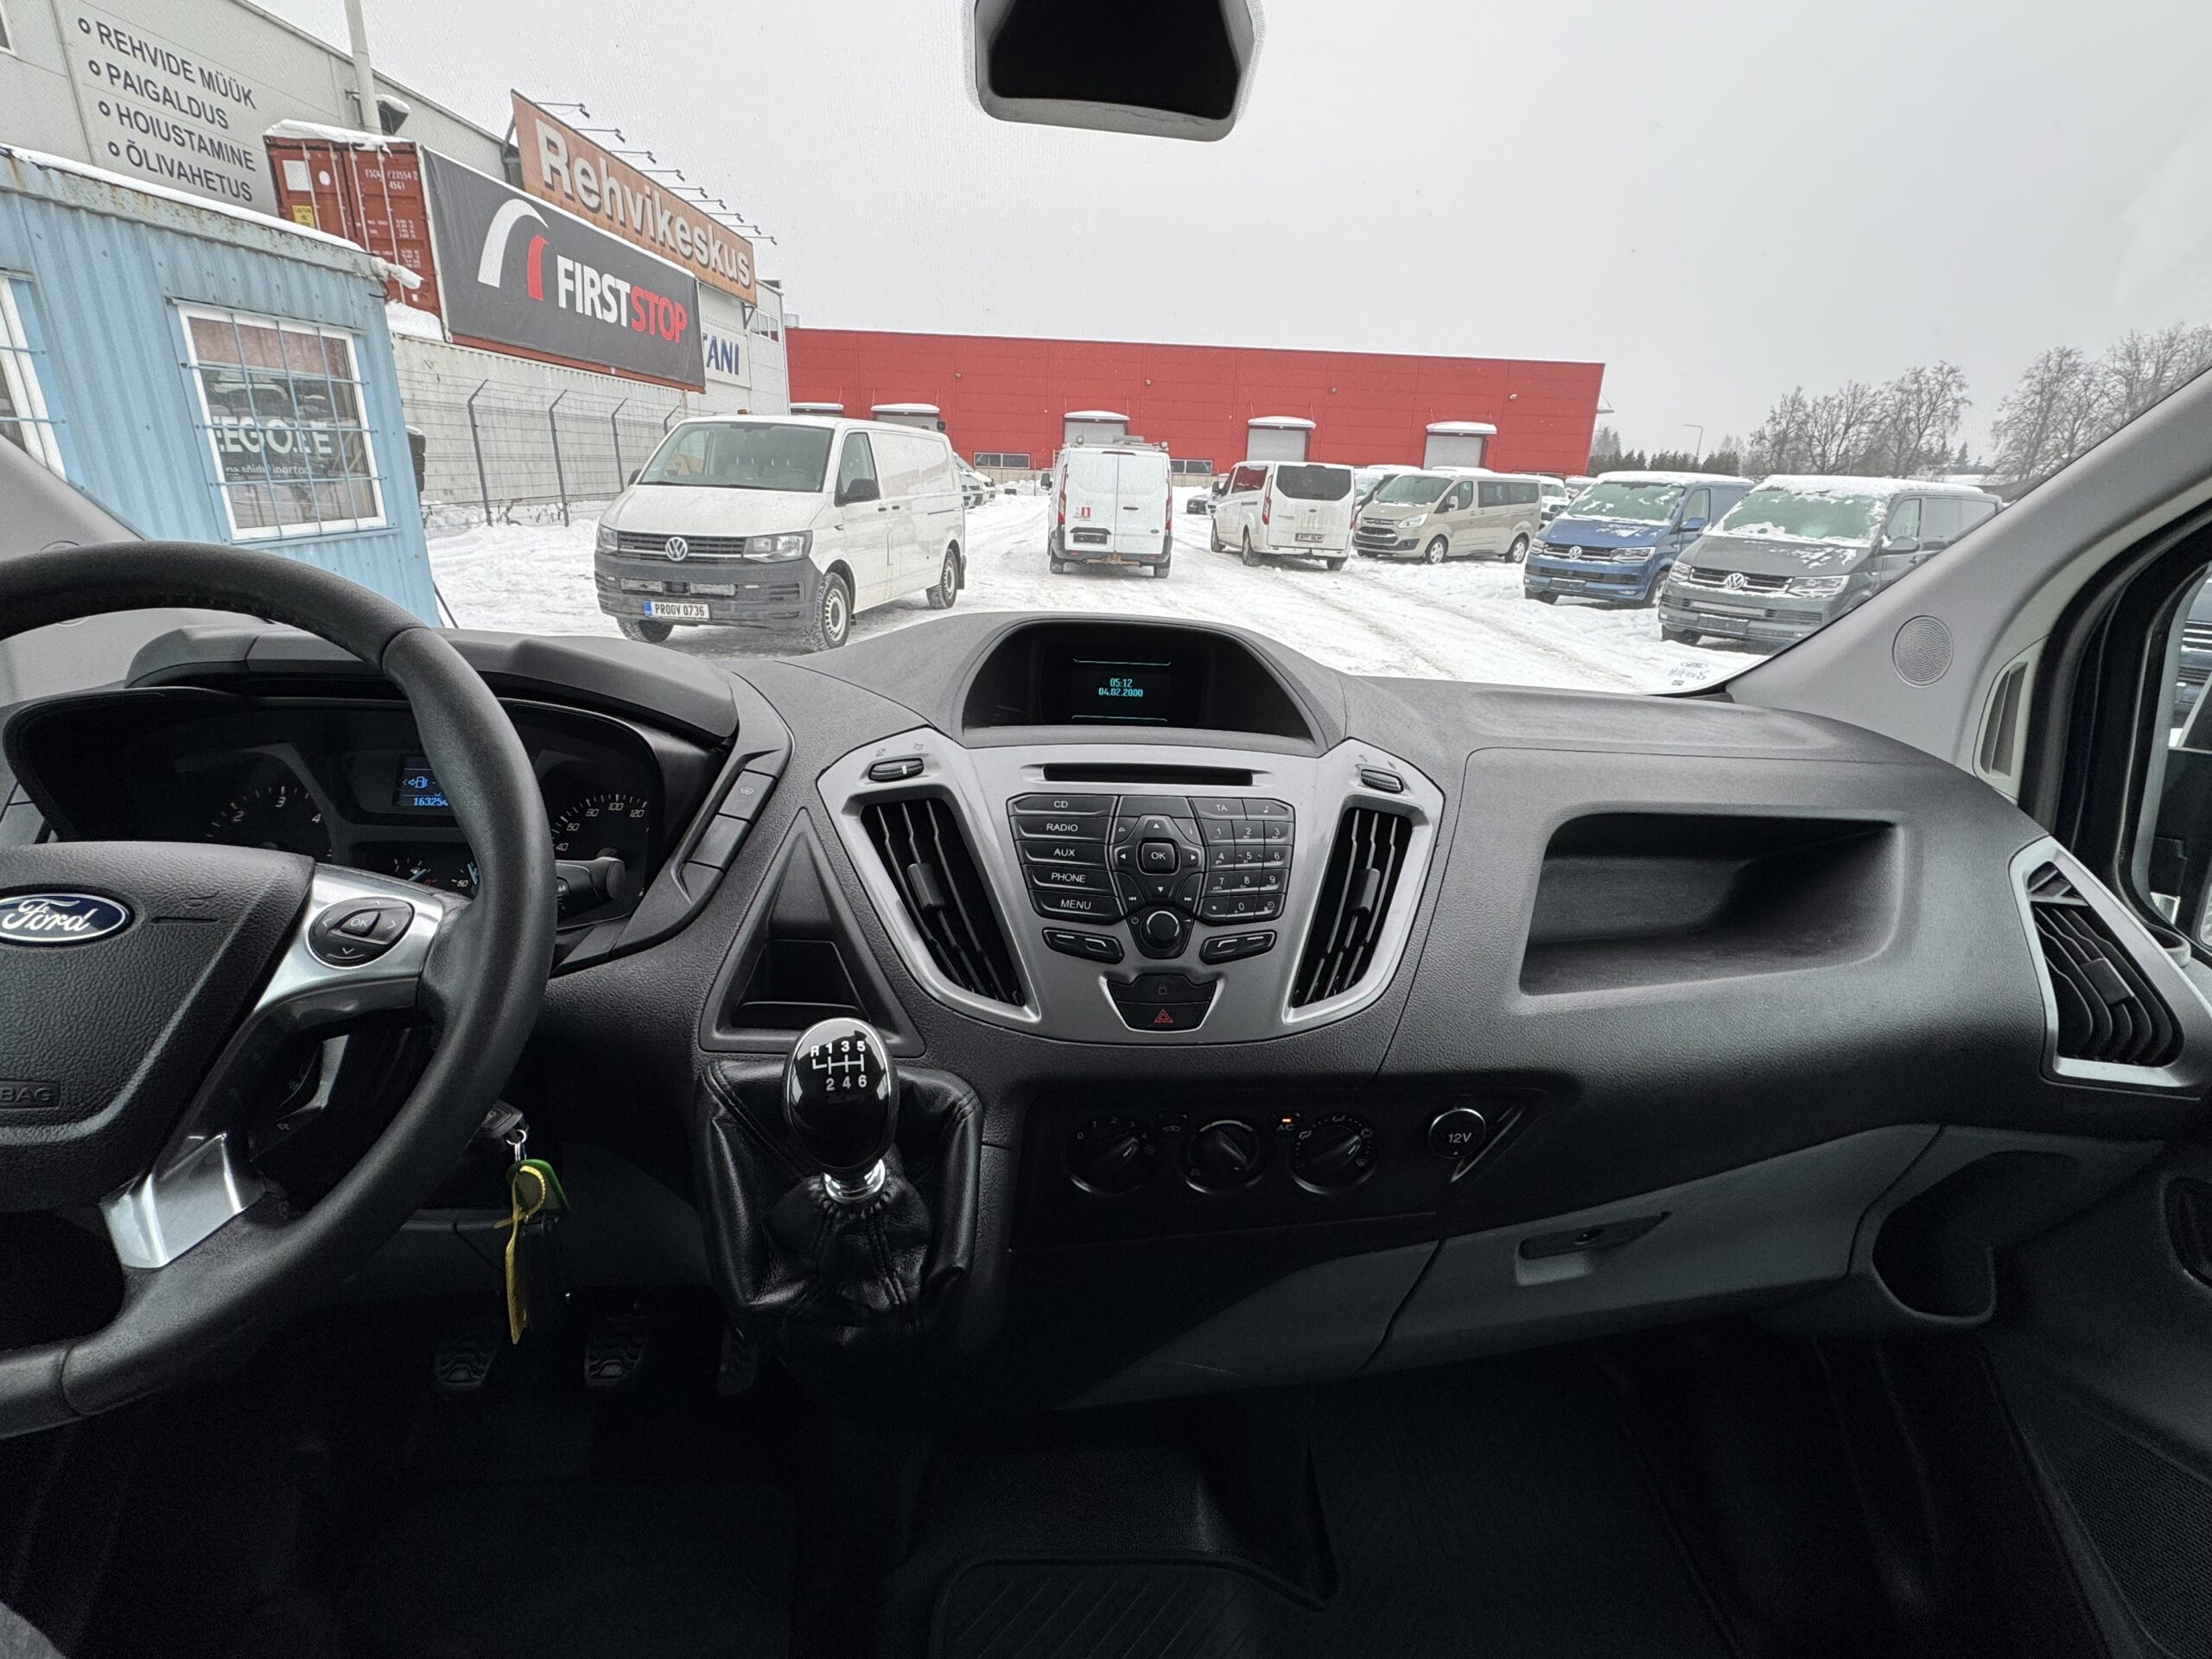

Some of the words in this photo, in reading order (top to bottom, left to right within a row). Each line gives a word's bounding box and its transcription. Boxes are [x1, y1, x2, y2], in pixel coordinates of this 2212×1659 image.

[95, 20, 196, 84] REHVIDE
[198, 67, 257, 110] MÜÜK
[105, 62, 229, 130] PAIGALDUS
[115, 102, 257, 172] HOIUSTAMINE
[126, 139, 253, 202] ÕLIVAHETUS
[536, 118, 753, 290] Rehvikeskus
[683, 606, 705, 616] 0736
[1109, 677, 1133, 688] 05:12
[1098, 687, 1144, 697] 04.02.2000
[275, 797, 287, 808] 3
[607, 802, 625, 811] 100
[1053, 800, 1069, 809] CD
[585, 808, 600, 817] 80
[1215, 804, 1228, 812] TA
[232, 810, 245, 822] 2
[311, 813, 322, 823] 4
[629, 809, 645, 818] 120
[566, 823, 580, 832] 60
[1046, 823, 1078, 832] RADIO
[1245, 827, 1252, 836] 2
[1274, 827, 1281, 836] 3
[555, 842, 569, 852] 40
[1053, 848, 1076, 857] AUX
[1151, 851, 1166, 861] OK
[1218, 852, 1224, 861] 4
[1246, 851, 1252, 860] 5
[1274, 851, 1280, 860] 6
[1051, 872, 1086, 883] PHONE
[1218, 877, 1224, 886] 7
[1244, 876, 1250, 885] 8
[1269, 875, 1275, 884] 9
[1060, 899, 1091, 910] MENU
[1238, 902, 1245, 911] 0
[2, 899, 99, 931] Ford
[350, 918, 368, 927] OK
[825, 1042, 833, 1054] 1
[841, 1040, 850, 1052] 3
[856, 1040, 866, 1052] 5
[826, 1077, 836, 1091] 2
[842, 1076, 851, 1089] 4
[858, 1074, 868, 1088] 6
[1277, 1123, 1294, 1132] A/C
[1448, 1132, 1472, 1143] 12V
